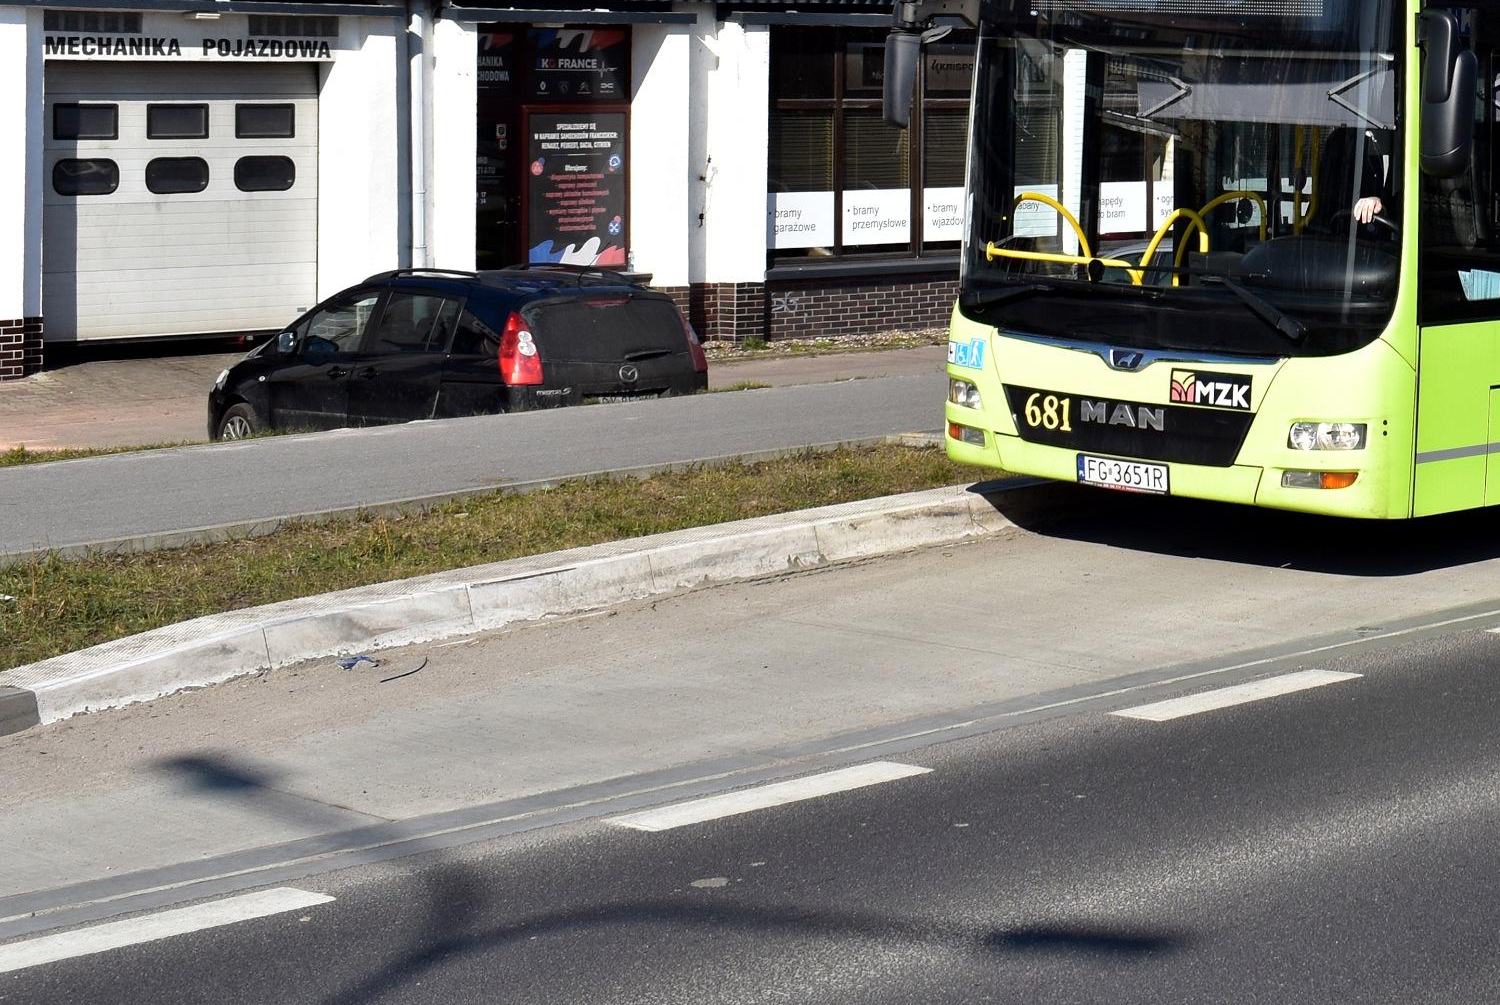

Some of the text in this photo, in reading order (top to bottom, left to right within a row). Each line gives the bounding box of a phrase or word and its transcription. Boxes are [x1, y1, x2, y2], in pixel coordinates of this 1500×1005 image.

[45, 36, 331, 58] MECHANIKA POJAZDOWA
[558, 59, 597, 68] FRANCE
[853, 205, 879, 216] bramy
[932, 203, 957, 214] bramy
[774, 209, 802, 220] bramy
[773, 222, 816, 235] garażowe
[852, 219, 906, 230] przemysłowe
[1195, 381, 1250, 408] MZK
[1025, 393, 1165, 432] 681 MAN
